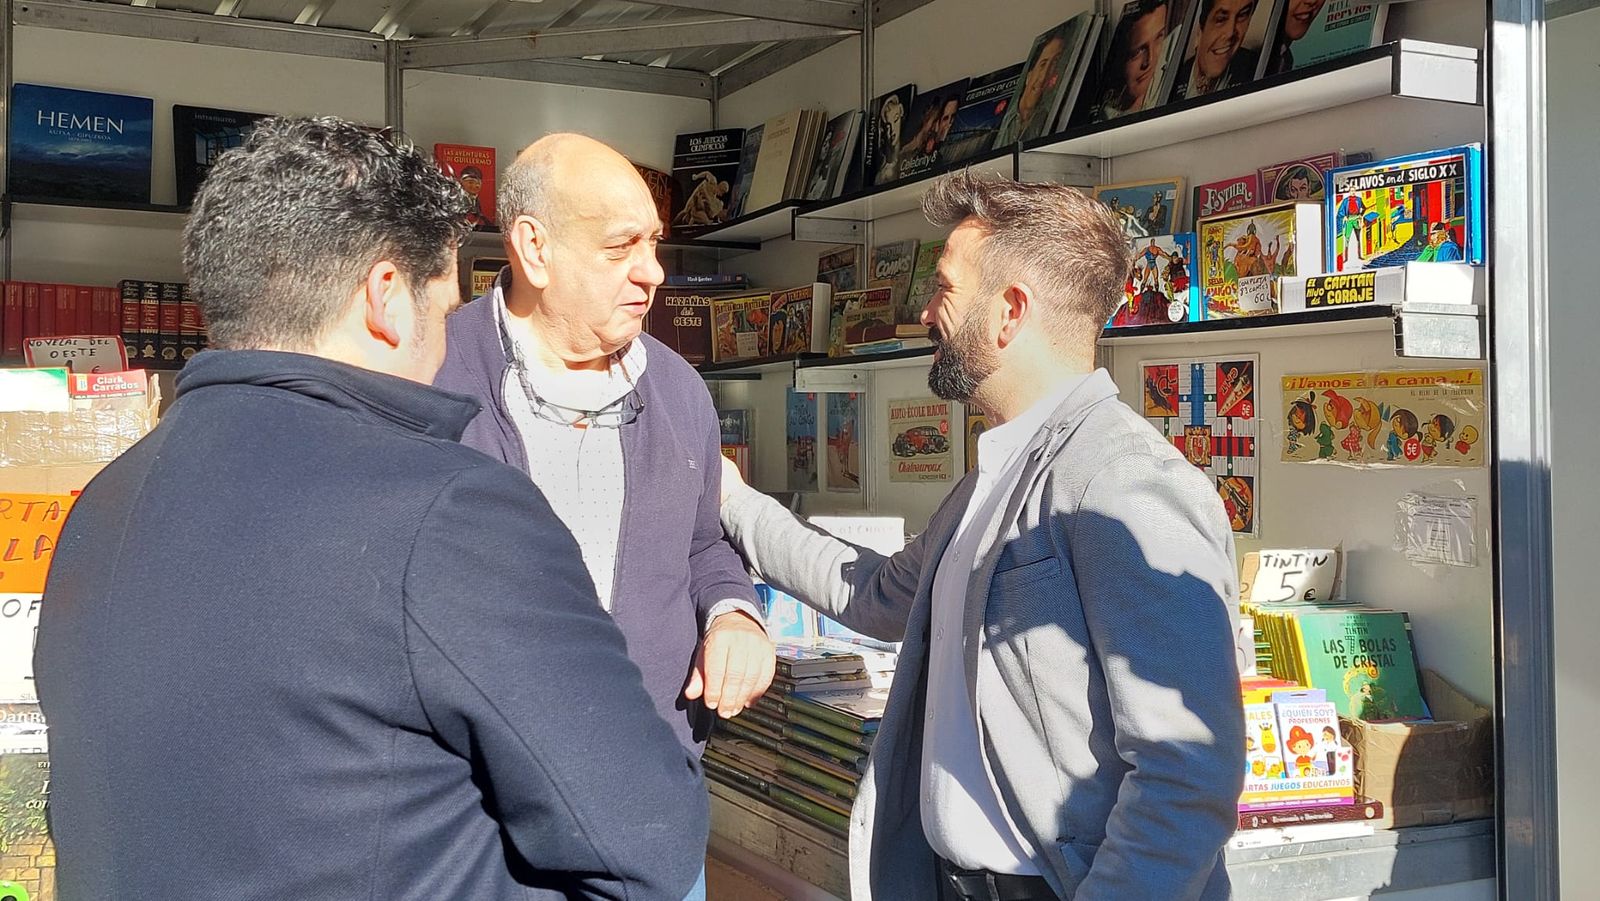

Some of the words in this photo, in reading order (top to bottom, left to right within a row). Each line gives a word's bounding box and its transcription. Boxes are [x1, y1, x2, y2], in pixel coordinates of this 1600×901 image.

[38, 110, 124, 134] HEMEN
[689, 138, 702, 147] LOS
[455, 151, 490, 159] AVENTURAS
[454, 157, 492, 166] GUILLERMO
[1338, 174, 1385, 192] ESCLAVOS
[1408, 168, 1437, 182] SIGLO
[1307, 278, 1317, 287] EL
[1324, 273, 1375, 290] CAPITAN
[1306, 287, 1325, 298] HIJO
[1326, 287, 1374, 304] CORAJE
[665, 295, 711, 306] HAZAÑAS
[673, 316, 702, 327] OESTE
[90, 338, 110, 346] DEL
[50, 348, 97, 359] OESTE
[96, 375, 124, 385] Clark
[92, 382, 140, 392] Carrados
[1405, 443, 1418, 457] 5€
[1267, 570, 1303, 603] 5
[1303, 588, 1317, 602] €
[1345, 627, 1369, 635] TINTIN
[1322, 639, 1346, 654] LAS
[1344, 635, 1356, 655] 7
[1358, 638, 1397, 653] BOLAS
[1333, 656, 1349, 669] DE
[1353, 655, 1396, 668] CRISTAL
[1314, 708, 1335, 717] SOY?
[1270, 782, 1301, 790] JUEGOS
[1302, 778, 1351, 789] EDUCATIVOS
